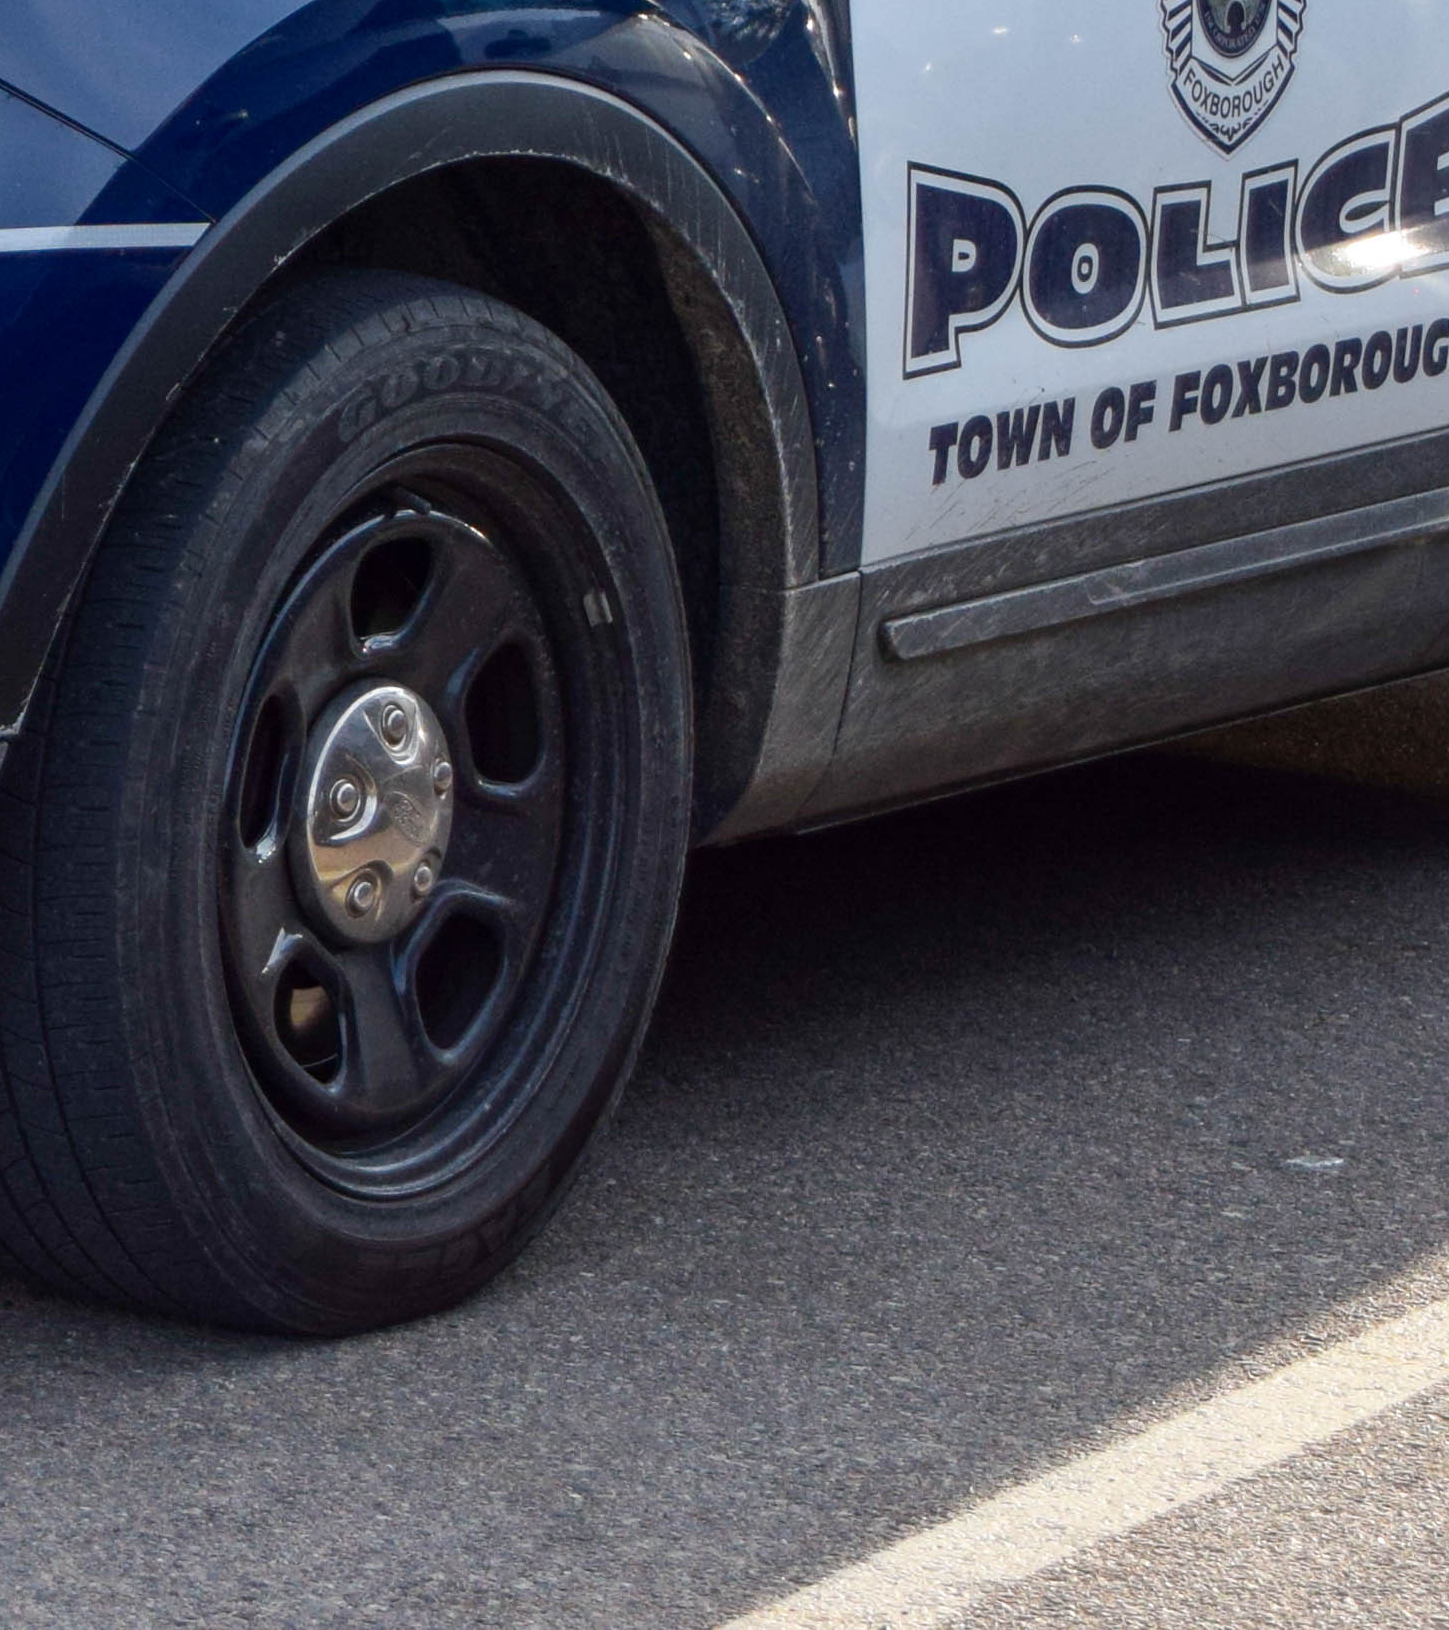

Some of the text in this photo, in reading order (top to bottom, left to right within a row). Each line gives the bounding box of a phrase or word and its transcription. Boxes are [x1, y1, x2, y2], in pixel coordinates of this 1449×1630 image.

[1183, 53, 1285, 119] FOXBOROUGH
[928, 396, 1076, 487] TOWN
[1090, 379, 1157, 449] OF
